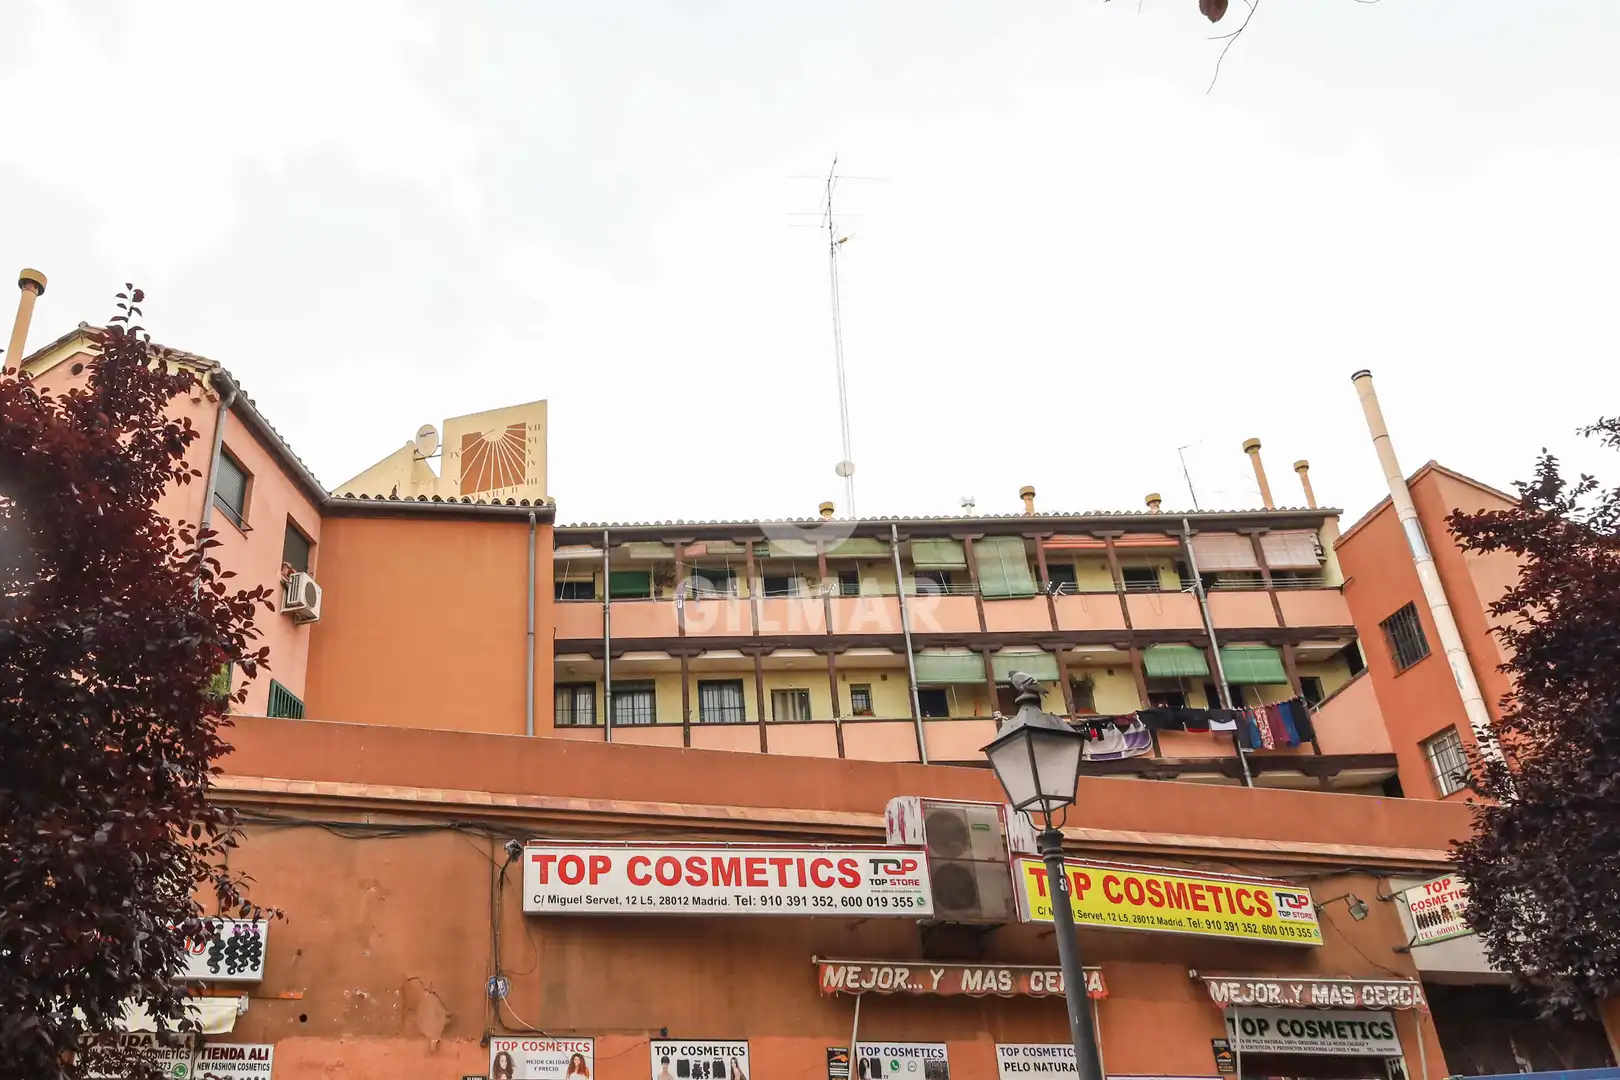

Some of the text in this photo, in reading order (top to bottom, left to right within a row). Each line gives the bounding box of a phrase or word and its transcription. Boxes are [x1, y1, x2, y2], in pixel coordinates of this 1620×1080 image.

[532, 854, 862, 888] TOP COSMETICS
[869, 858, 918, 875] TOP
[1028, 868, 1272, 918] TP COSMETICS
[1423, 878, 1451, 895] TOP
[533, 894, 914, 908] C/ Miguel Servet, 12 L5, 28012 Madrid. Tel: 910 391 352, 600 019 355
[1274, 892, 1309, 908] TOP
[1410, 888, 1466, 912] COSMETIC
[1292, 911, 1313, 920] STORE
[1077, 910, 1106, 921] Servet,
[1107, 913, 1117, 921] 12
[1119, 913, 1131, 923] L5,
[1133, 915, 1155, 924] 28012
[1157, 916, 1186, 927] Madrid.
[1187, 917, 1203, 929] Tel:
[1205, 919, 1222, 930] 910
[1224, 921, 1240, 932] 391
[1242, 923, 1261, 936] 352,
[1262, 924, 1278, 935] 600
[1279, 926, 1295, 936] 019
[1297, 928, 1312, 938] 355
[1420, 924, 1466, 940] TEL.600019
[930, 968, 945, 990] Y
[961, 968, 1013, 991] MAS
[1030, 970, 1102, 992] CEA
[1311, 984, 1355, 1004] MAS
[1362, 985, 1426, 1005] CERCA
[1226, 1018, 1394, 1040] TOP COSMETICS
[201, 1047, 269, 1060] TIENDA ALI
[494, 1041, 590, 1052] TOP COSMETICS
[655, 1046, 746, 1056] TOP COSMETICS
[860, 1047, 944, 1058] TOP COSMETICS
[1000, 1047, 1019, 1056] TOP
[197, 1062, 270, 1071] NEW FASHION COSMETICS
[1004, 1062, 1031, 1072] PELO
